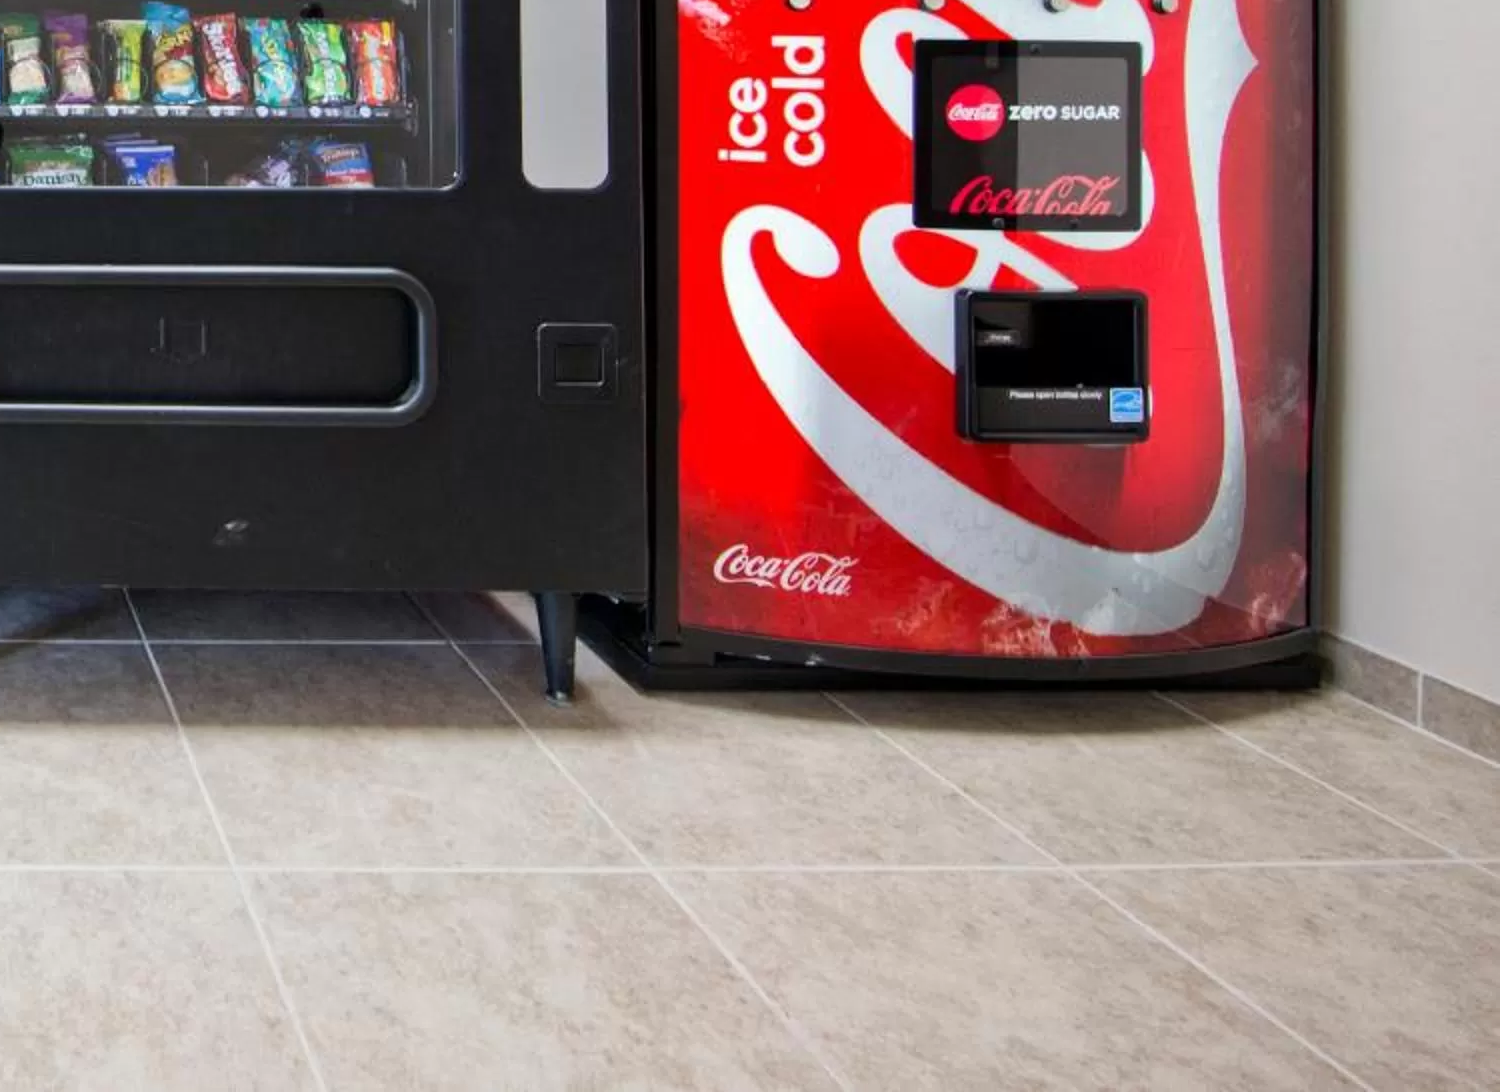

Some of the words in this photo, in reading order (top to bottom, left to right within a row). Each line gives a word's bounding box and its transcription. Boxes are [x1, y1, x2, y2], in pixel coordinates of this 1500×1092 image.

[717, 77, 768, 162] ice
[771, 35, 825, 167] cold
[949, 103, 1002, 121] Coca-Cola
[1008, 105, 1057, 121] zero
[1061, 105, 1121, 121] SUGAR
[949, 175, 1121, 216] Coca-Cola
[1008, 391, 1034, 400] Please
[713, 543, 860, 596] Coca-Cola
